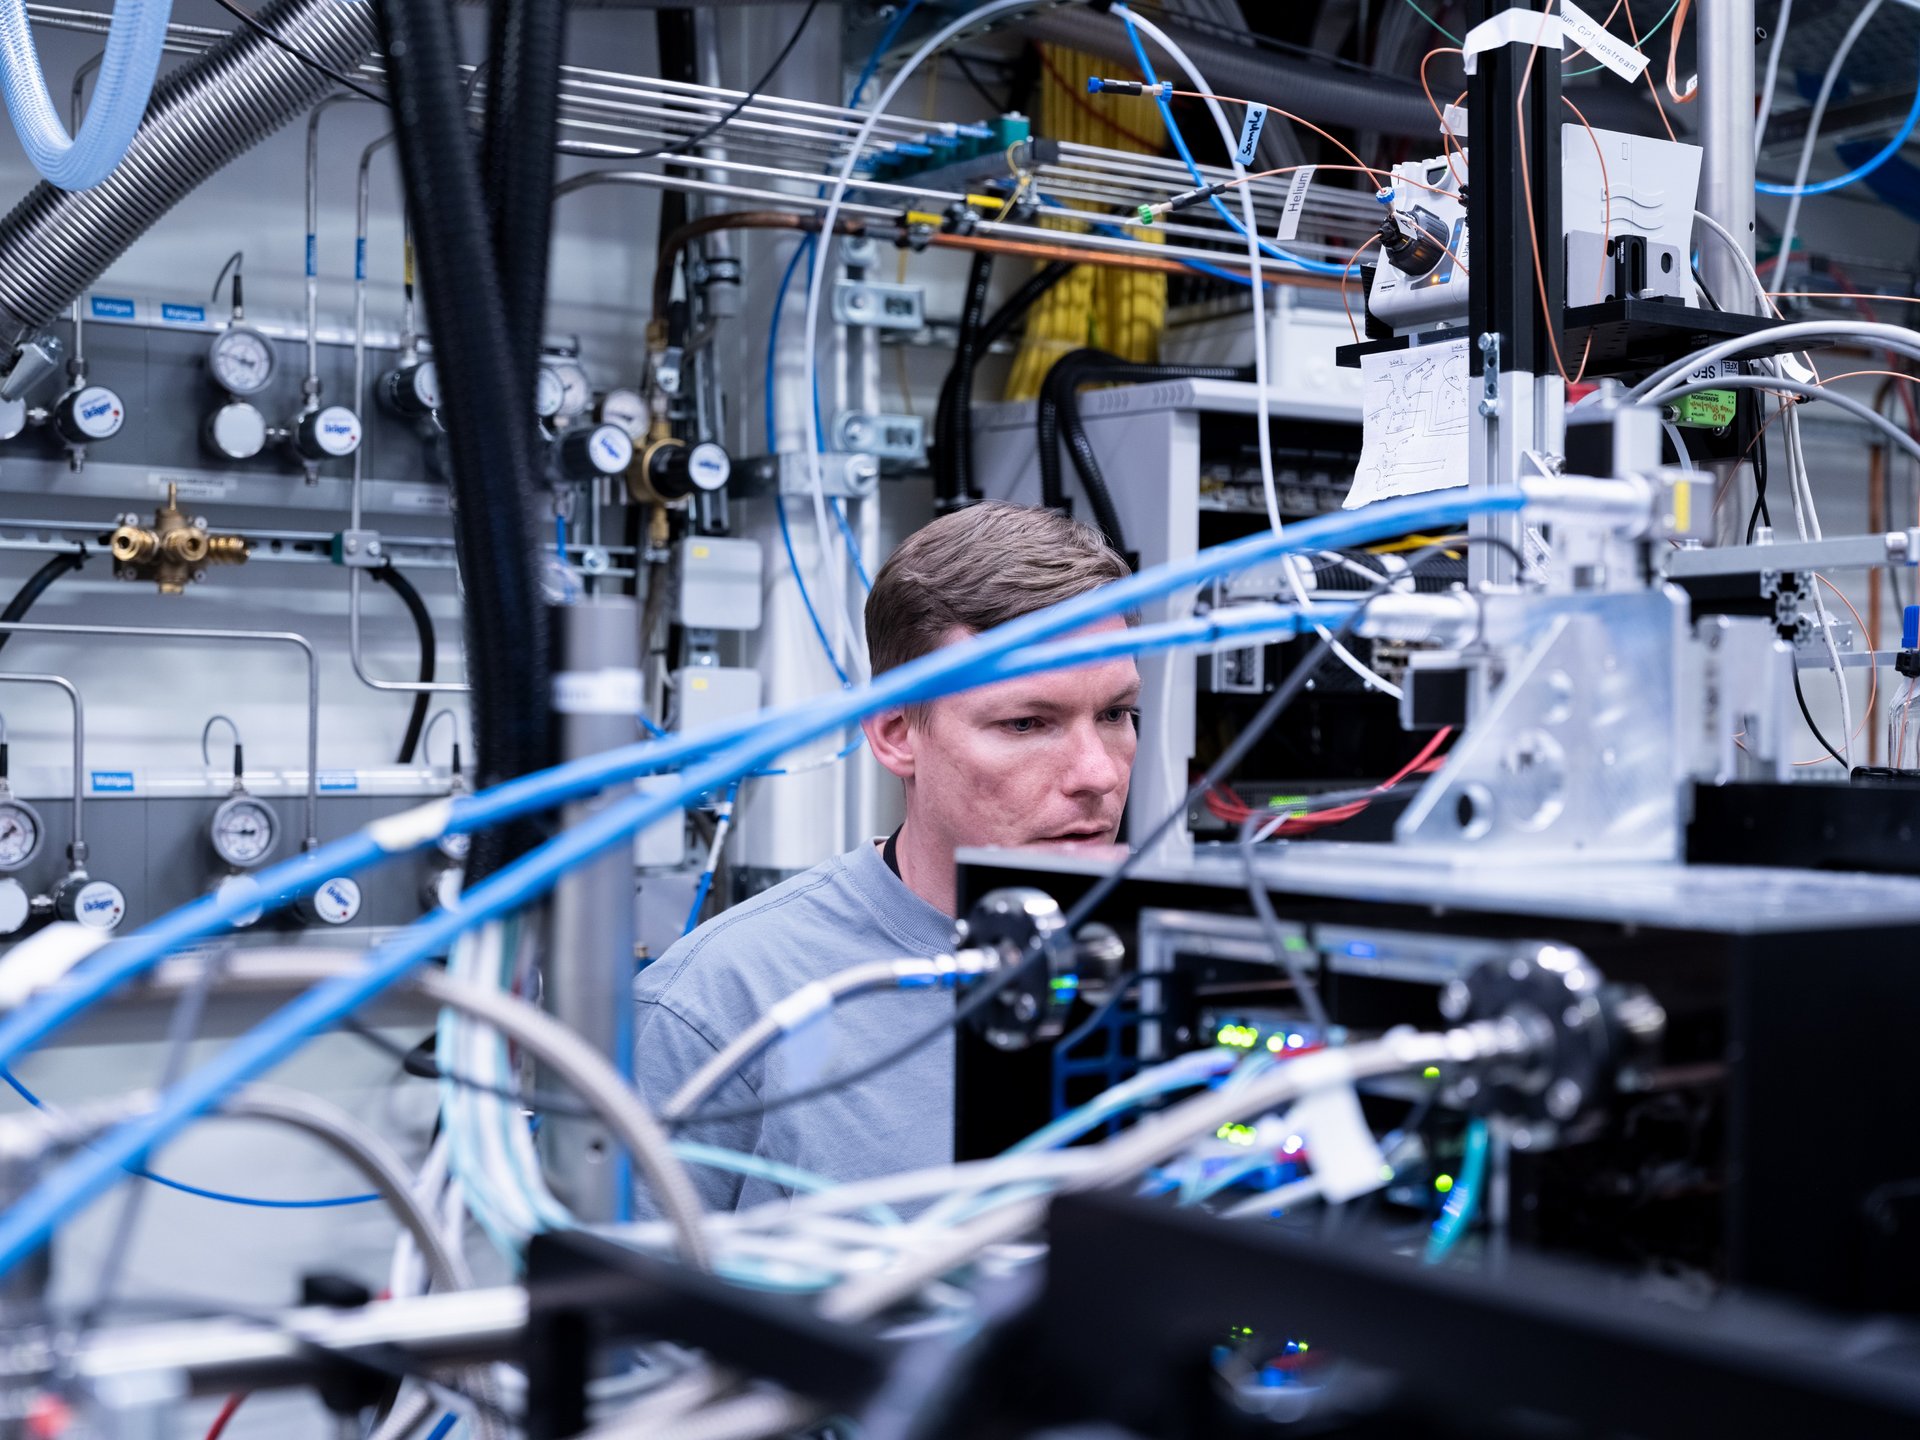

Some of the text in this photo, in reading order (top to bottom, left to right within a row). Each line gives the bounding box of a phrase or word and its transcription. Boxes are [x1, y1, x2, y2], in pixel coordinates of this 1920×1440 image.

[1596, 42, 1638, 72] upstream
[1242, 110, 1262, 156] Sample
[1288, 172, 1310, 212] Helium
[1723, 361, 1738, 370] XFEL
[1691, 394, 1719, 402] SENSIRION
